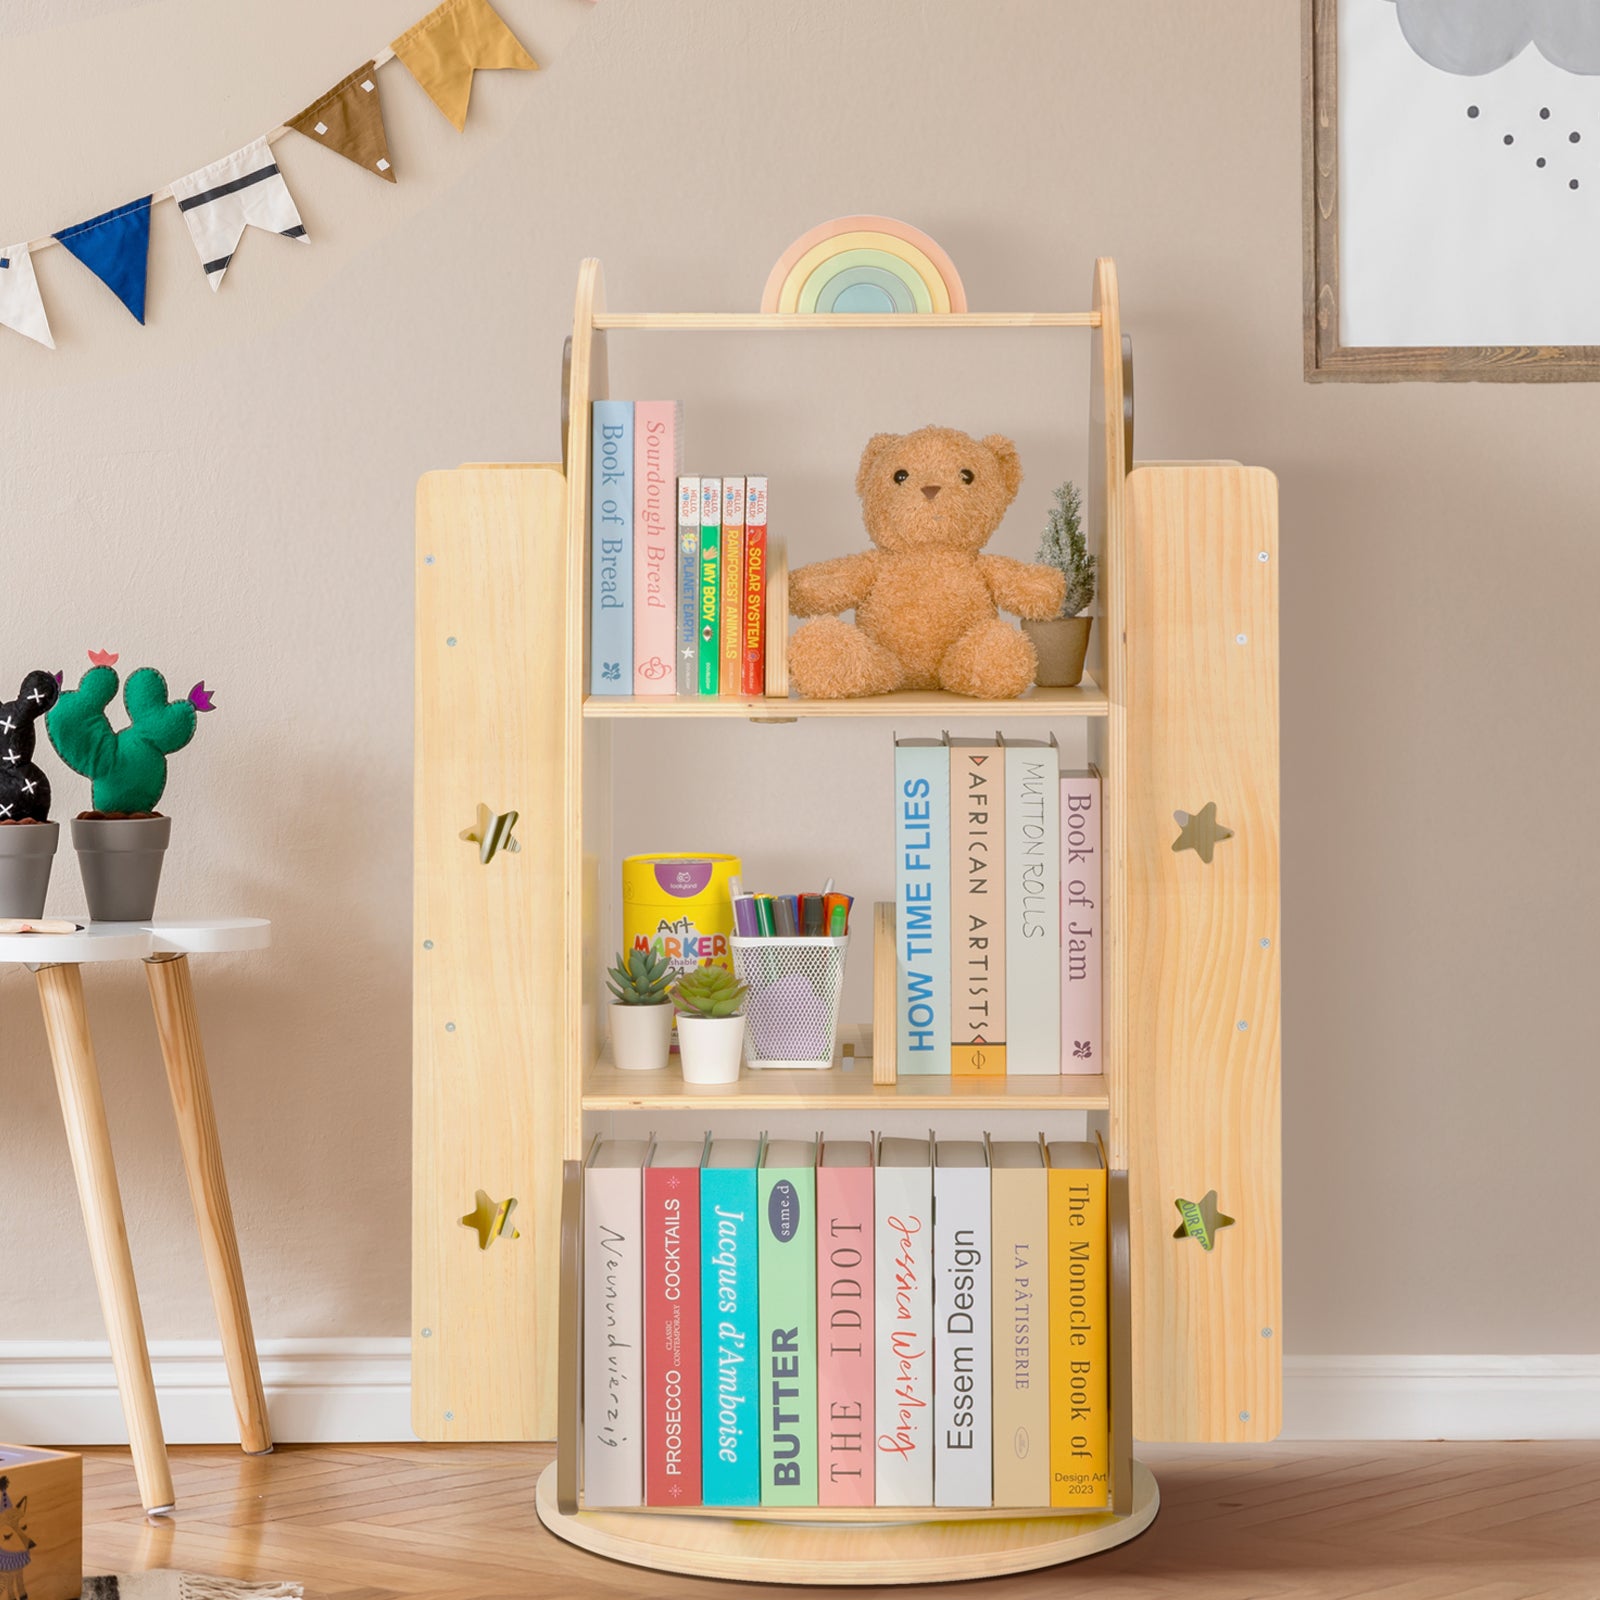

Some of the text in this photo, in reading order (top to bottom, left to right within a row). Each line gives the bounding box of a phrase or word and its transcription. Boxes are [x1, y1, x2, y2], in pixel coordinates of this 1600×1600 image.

[601, 424, 624, 610] Book of Bread
[642, 421, 666, 608] Sourdough Bread
[727, 530, 739, 603] RAINFOREST
[683, 556, 694, 642] PLANET EARTH
[703, 563, 716, 622] MY BODY
[725, 606, 738, 659] ANIMALS
[748, 548, 761, 648] SOLAR SYSTEM
[968, 772, 988, 1030] AFRICAN ARTISTS
[1021, 762, 1046, 938] MUTTON ROLLS
[1067, 793, 1094, 981] Book of Jam
[634, 935, 726, 958] MARKER
[657, 916, 694, 935] Art
[904, 778, 935, 1051] HOW TIME FLIES
[665, 1198, 681, 1300] COCKTAILS
[712, 1205, 744, 1313] Jacques
[777, 1185, 792, 1236] same.d
[888, 1215, 922, 1319] Jessica
[1015, 1244, 1032, 1390] LA PÂTISSERIE
[665, 1320, 673, 1351] CLASSIC
[830, 1218, 862, 1483] THE IDDOT
[947, 1230, 981, 1449] Essem Design
[1068, 1184, 1093, 1459] The Monocle Book of
[665, 1370, 681, 1475] PROSECCO
[772, 1327, 801, 1486] BUTTER
[1055, 1473, 1107, 1484] Design Art
[1069, 1485, 1094, 1494] 2023
